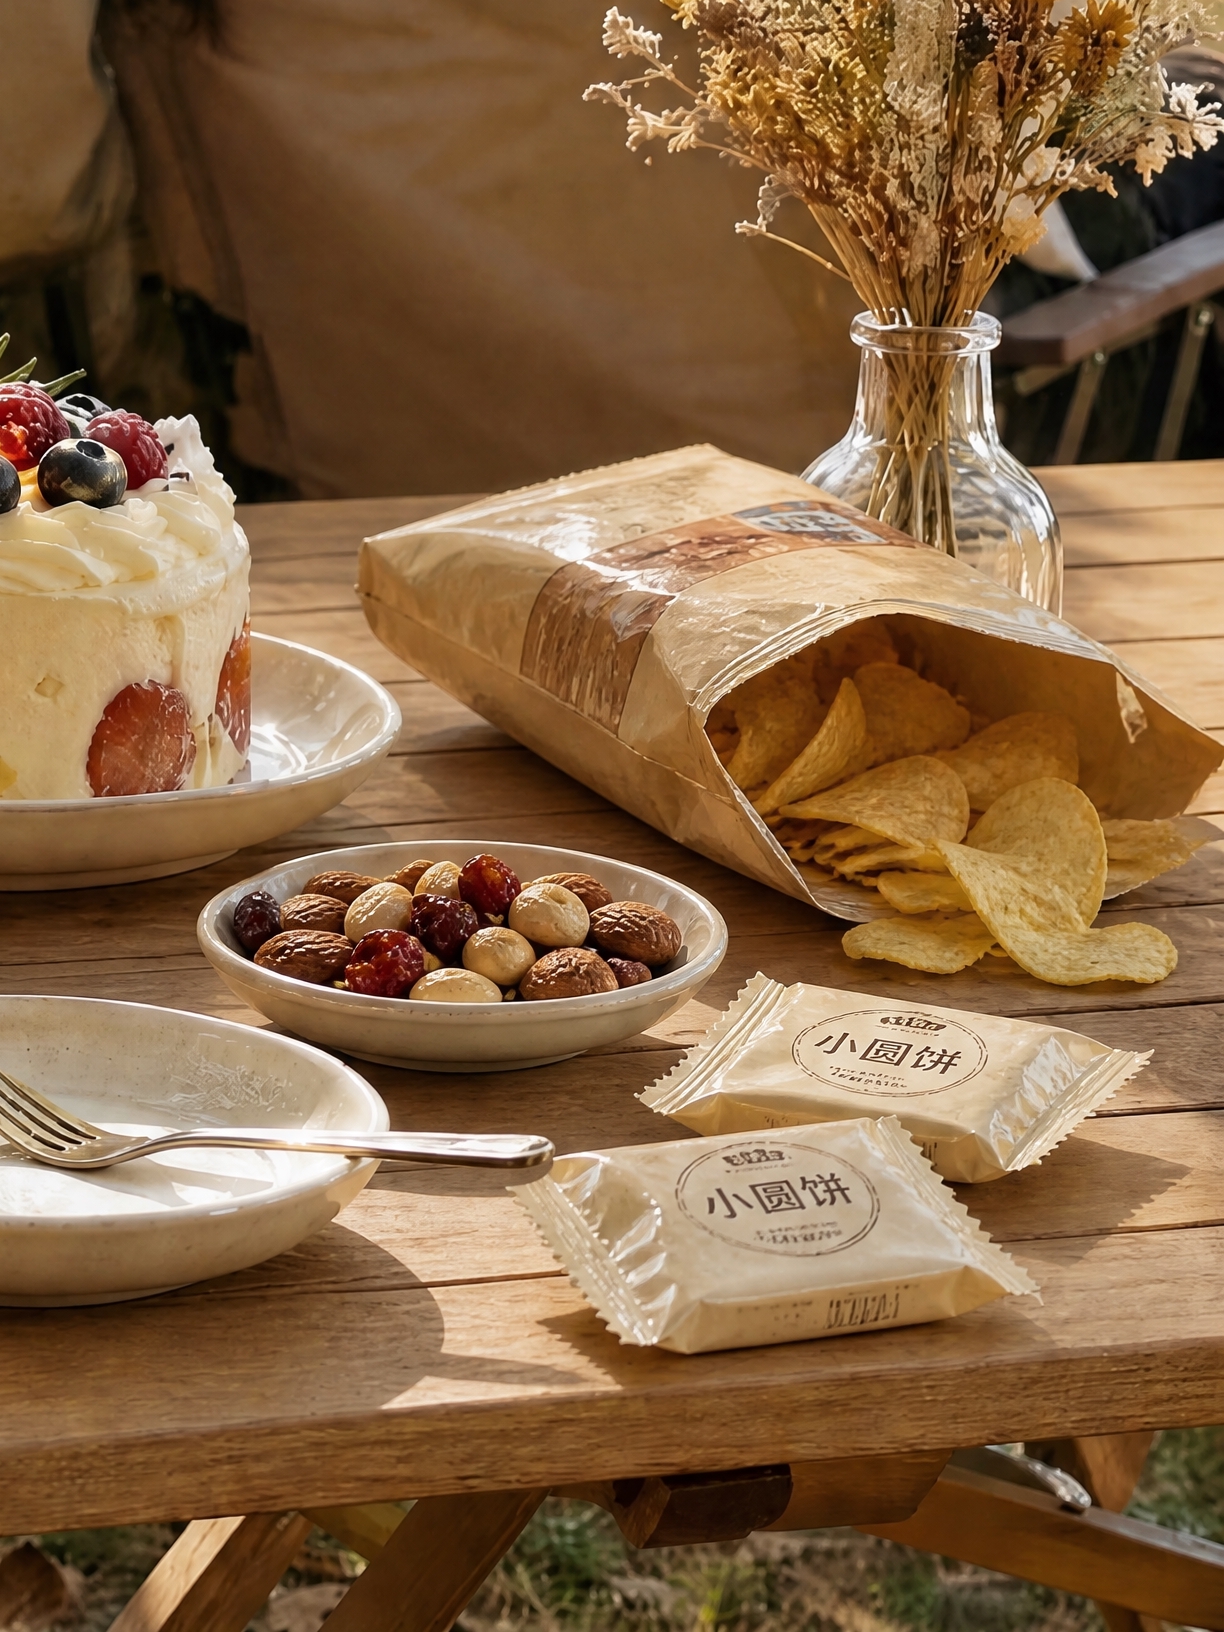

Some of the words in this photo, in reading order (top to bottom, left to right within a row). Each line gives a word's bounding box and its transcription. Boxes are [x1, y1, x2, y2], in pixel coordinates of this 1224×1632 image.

[814, 1032, 963, 1075] 小圆饼
[706, 1172, 853, 1219] 小圆饼
